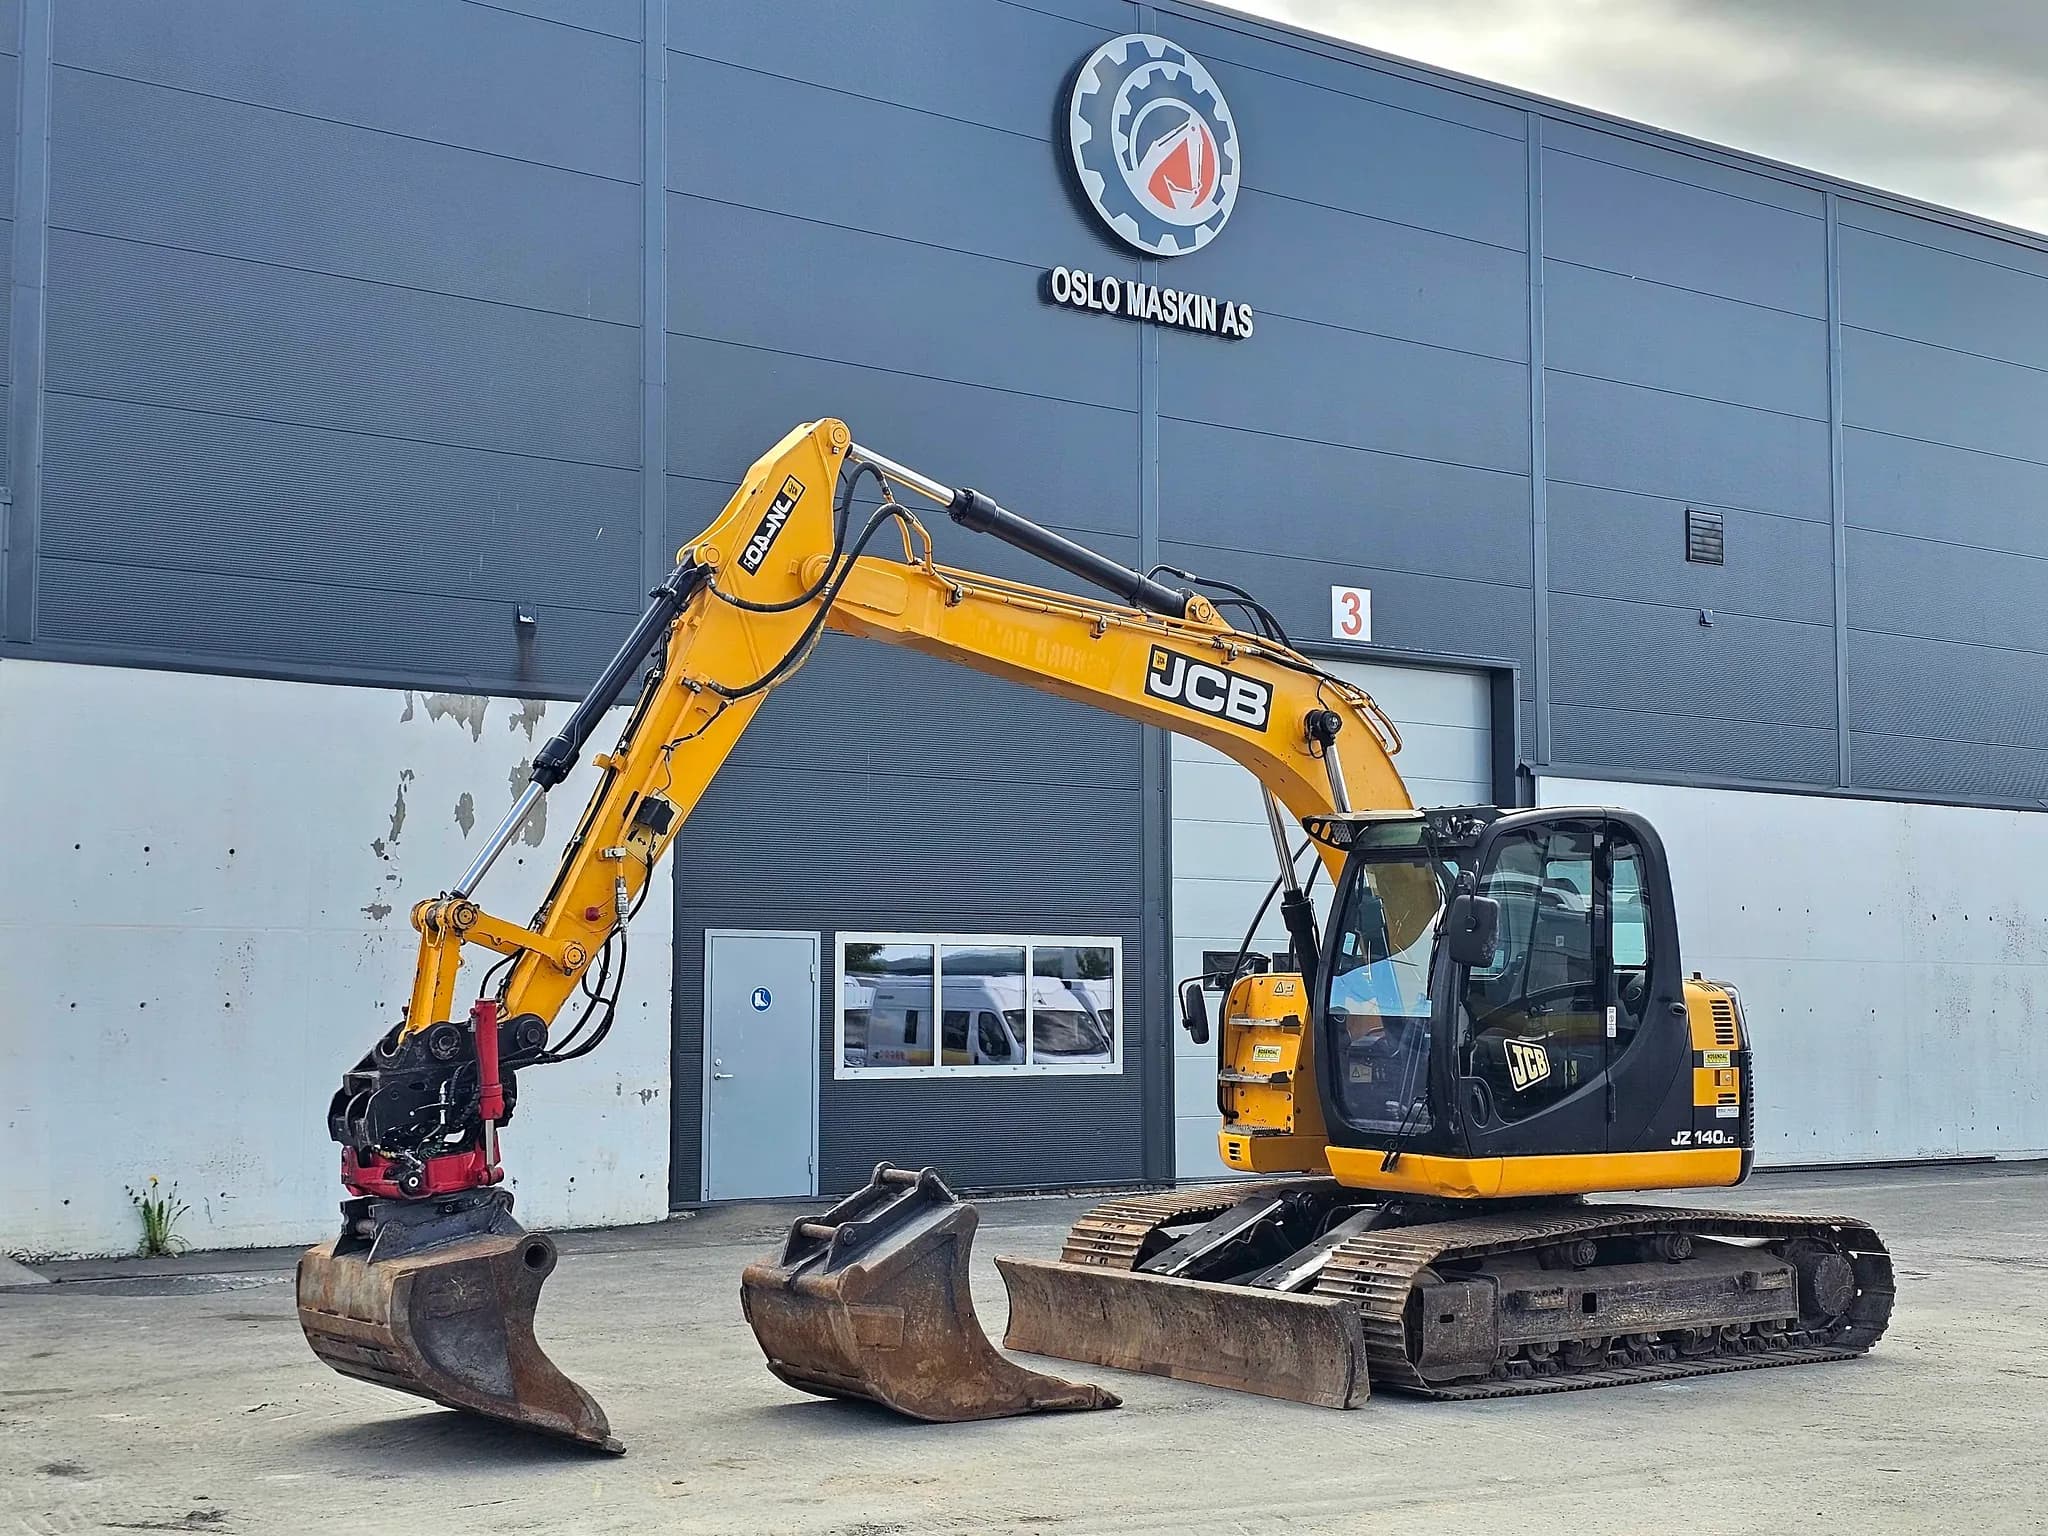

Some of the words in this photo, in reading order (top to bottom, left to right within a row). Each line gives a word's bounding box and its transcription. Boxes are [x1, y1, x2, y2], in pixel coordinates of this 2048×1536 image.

[1052, 266, 1121, 312] OSLO
[1126, 280, 1217, 332] MASKIN
[1221, 301, 1254, 338] AS
[1341, 592, 1362, 635] 3
[1150, 657, 1267, 726] JCB
[1511, 1044, 1548, 1086] JCB
[1670, 1130, 1692, 1145] JZ
